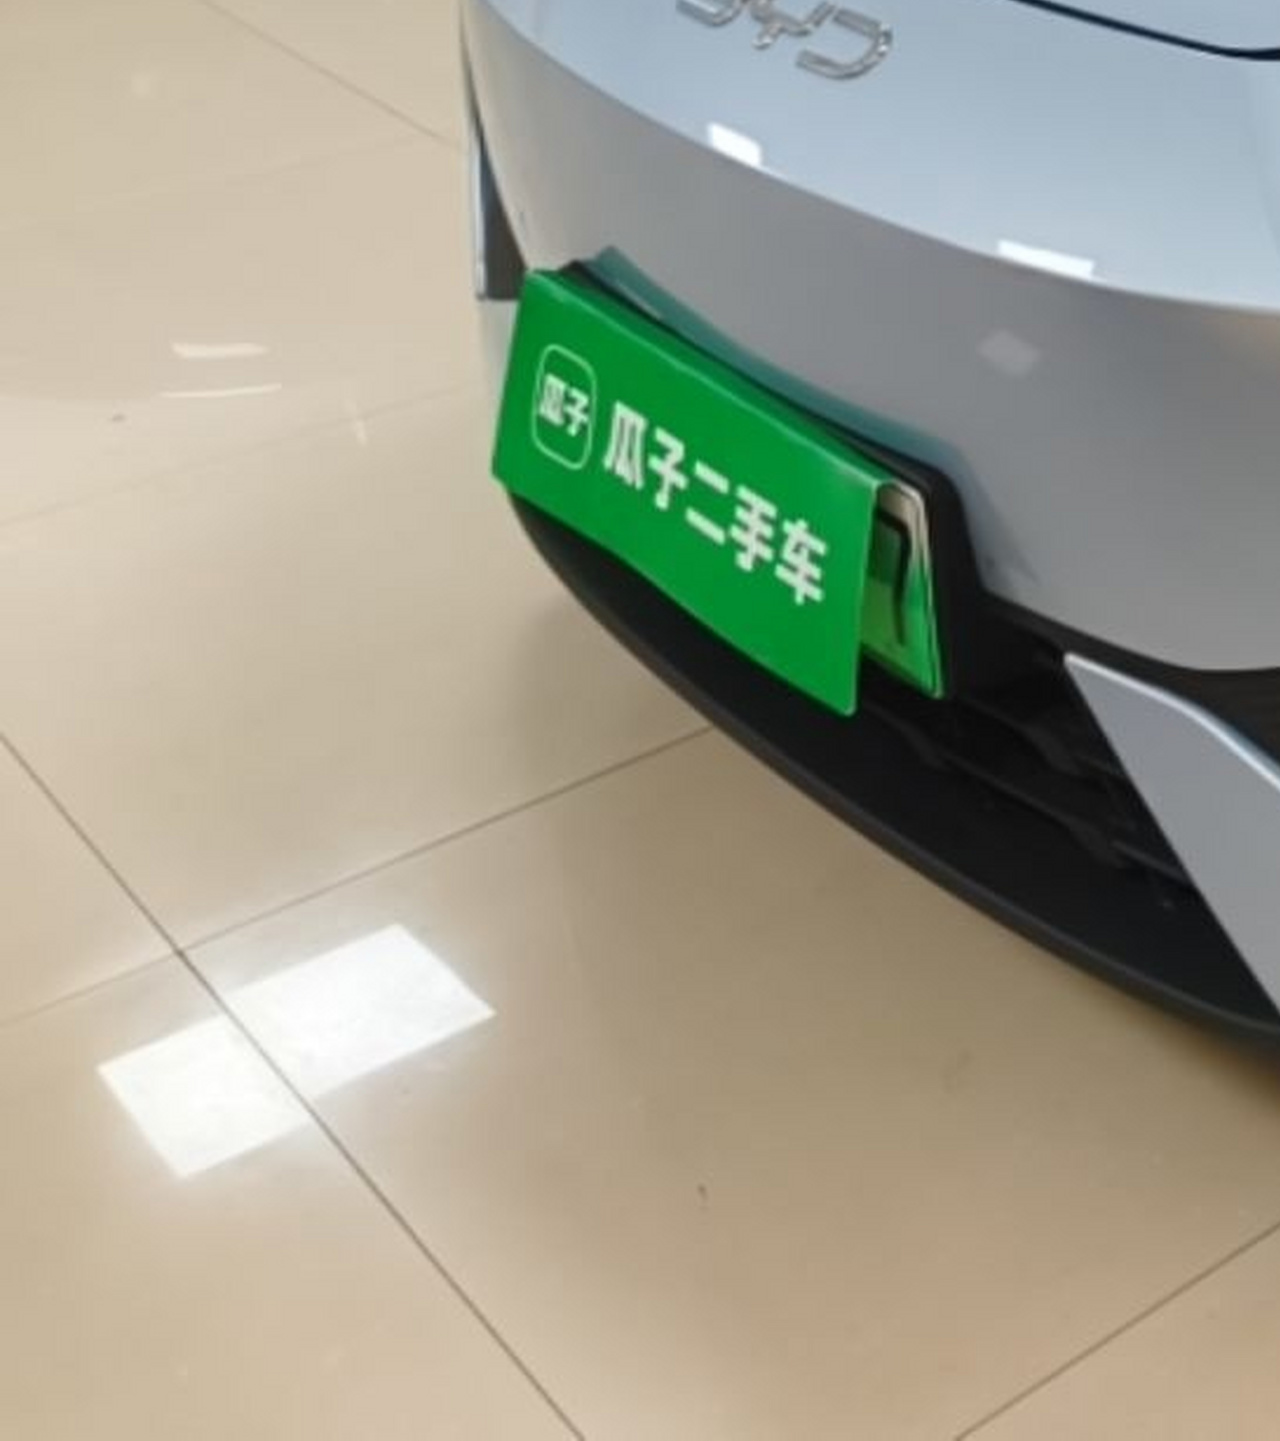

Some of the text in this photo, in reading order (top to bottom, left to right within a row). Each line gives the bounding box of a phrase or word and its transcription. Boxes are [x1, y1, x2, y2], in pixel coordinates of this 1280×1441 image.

[539, 373, 590, 437] 瓜子
[603, 401, 828, 606] 瓜子二手车
